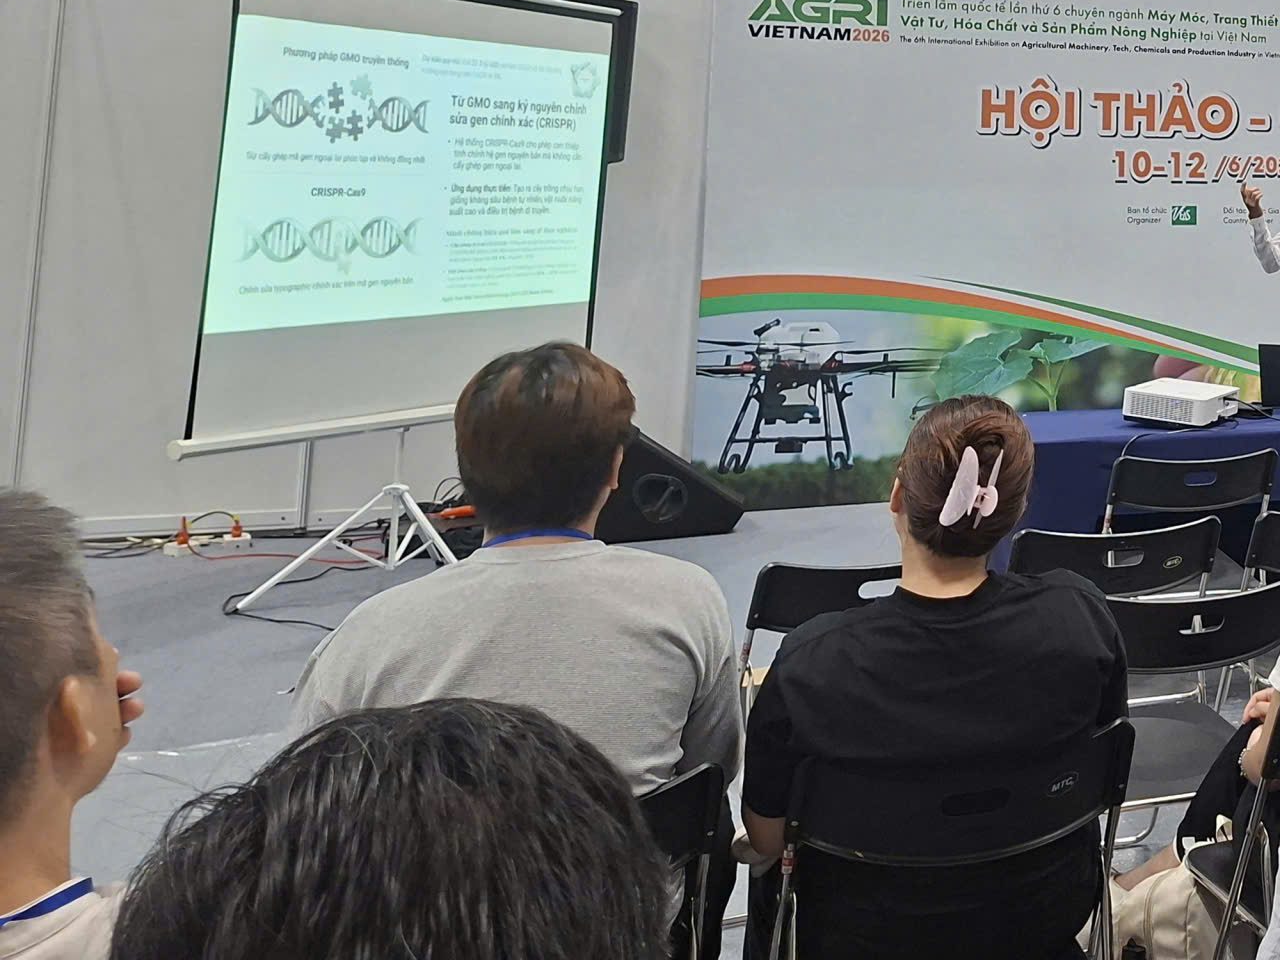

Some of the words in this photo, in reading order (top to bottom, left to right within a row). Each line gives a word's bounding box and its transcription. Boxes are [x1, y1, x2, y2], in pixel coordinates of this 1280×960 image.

[962, 0, 991, 14] quốc
[996, 0, 1006, 12] tế
[1032, 3, 1049, 15] thứ
[1053, 5, 1060, 15] 6
[1065, 5, 1104, 19] chuyên
[1109, 8, 1143, 21] ngành
[1148, 10, 1175, 24] Máy
[1180, 12, 1209, 24] Móc,
[1214, 13, 1247, 28] Trang
[1251, 14, 1278, 26] Thiết
[901, 16, 924, 30] Vật
[928, 16, 948, 30] Tư,
[954, 18, 982, 30] Hóa
[987, 18, 1017, 32] Chất
[1022, 21, 1038, 32] và
[1042, 21, 1066, 34] Sản
[1071, 22, 1106, 35] Phẩm
[1112, 26, 1146, 40] Nông
[1151, 28, 1196, 43] Nghiệp
[1200, 31, 1213, 43] tại
[1216, 31, 1237, 44] Việt
[1241, 32, 1266, 43] Nam
[340, 52, 360, 63] GMO
[928, 36, 972, 45] International
[975, 39, 1009, 47] Exhibition
[1022, 41, 1066, 50] Agricultural
[1068, 43, 1110, 53] Machinery,
[1134, 46, 1170, 54] Chemicals
[1188, 48, 1225, 56] Production
[1227, 50, 1255, 59] Industry
[467, 96, 491, 109] GMO
[494, 100, 515, 112] sang
[530, 102, 561, 115] nguyên
[979, 77, 1076, 143] HỘI
[1092, 81, 1235, 134] THẢO
[470, 116, 488, 128] gen
[518, 116, 534, 128] xác
[536, 118, 576, 131] (CRISPR)
[1113, 150, 1207, 180] 10-12
[311, 187, 366, 197] CRISPR-Cas9
[1127, 217, 1161, 225] Organizer
